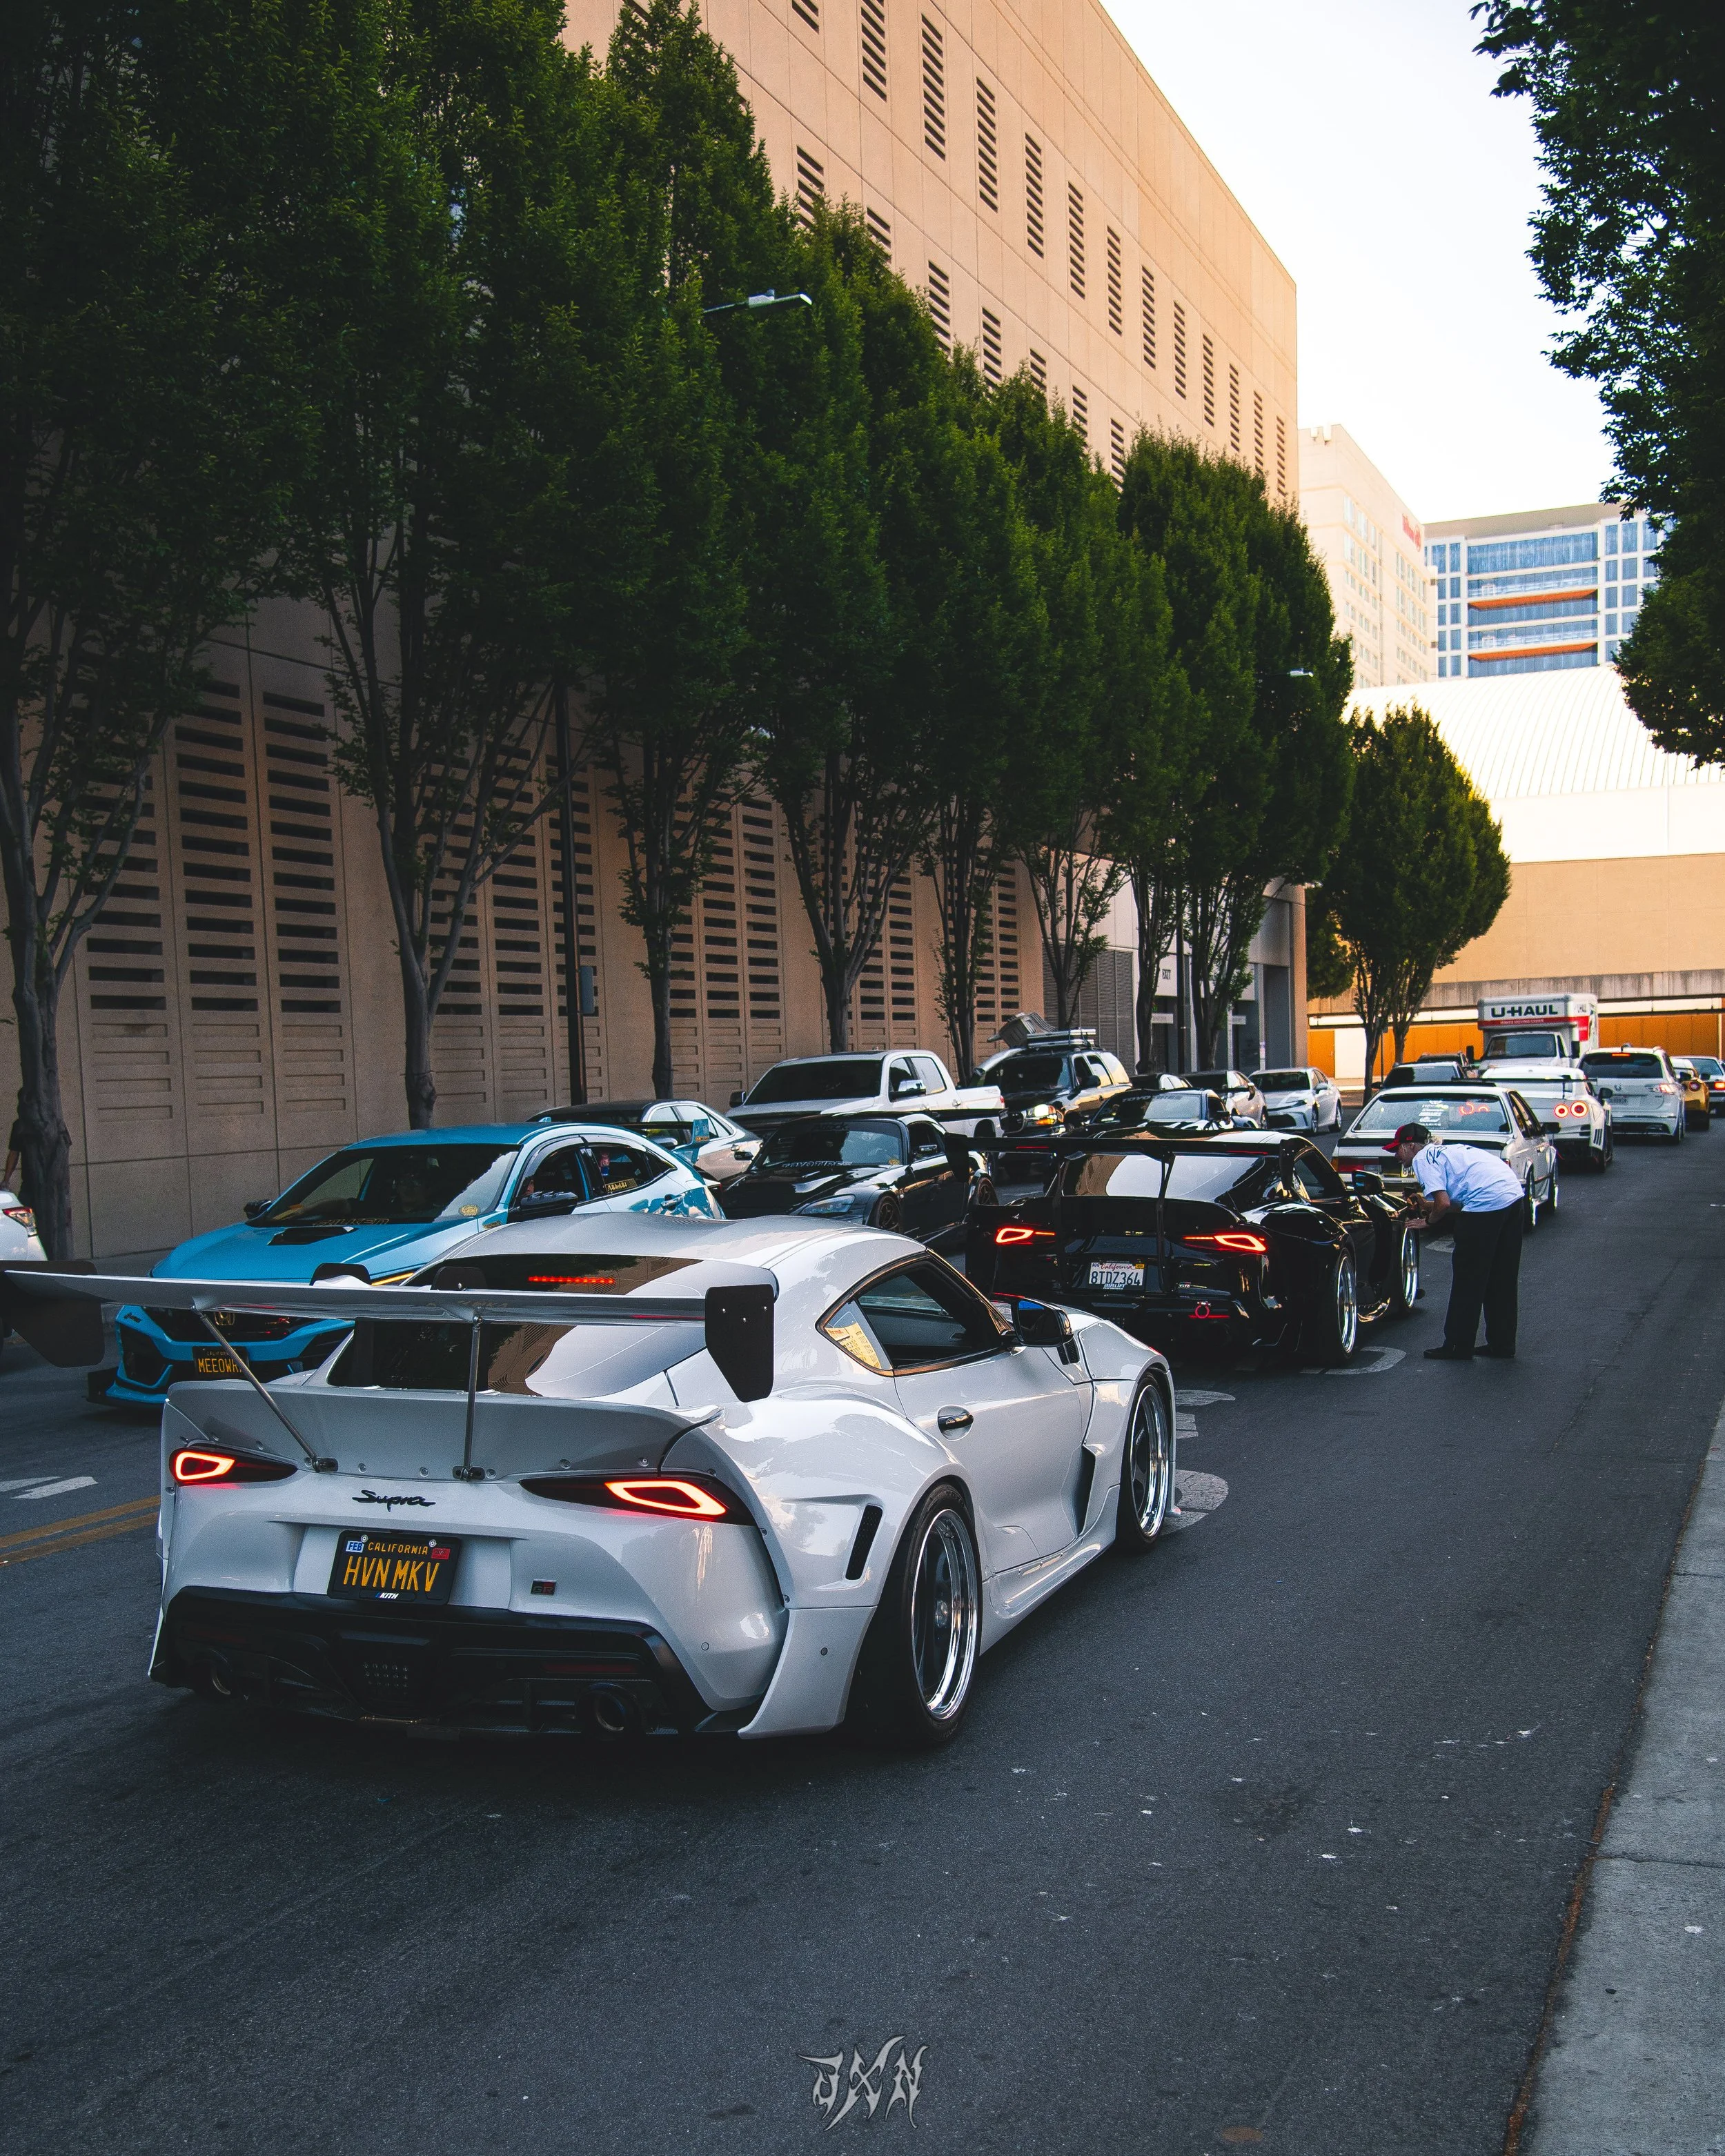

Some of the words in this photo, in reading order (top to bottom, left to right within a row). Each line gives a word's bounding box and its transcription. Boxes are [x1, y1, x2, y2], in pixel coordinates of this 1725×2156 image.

[1491, 1005, 1558, 1018] U-HAUL
[1101, 1263, 1136, 1272] California
[1091, 1271, 1141, 1285] 8TDZ364
[351, 1490, 437, 1512] Supra
[348, 1541, 363, 1552] FEB
[368, 1542, 428, 1555] CALIFORNIA
[343, 1555, 391, 1588] HVN
[391, 1559, 440, 1592] MKV
